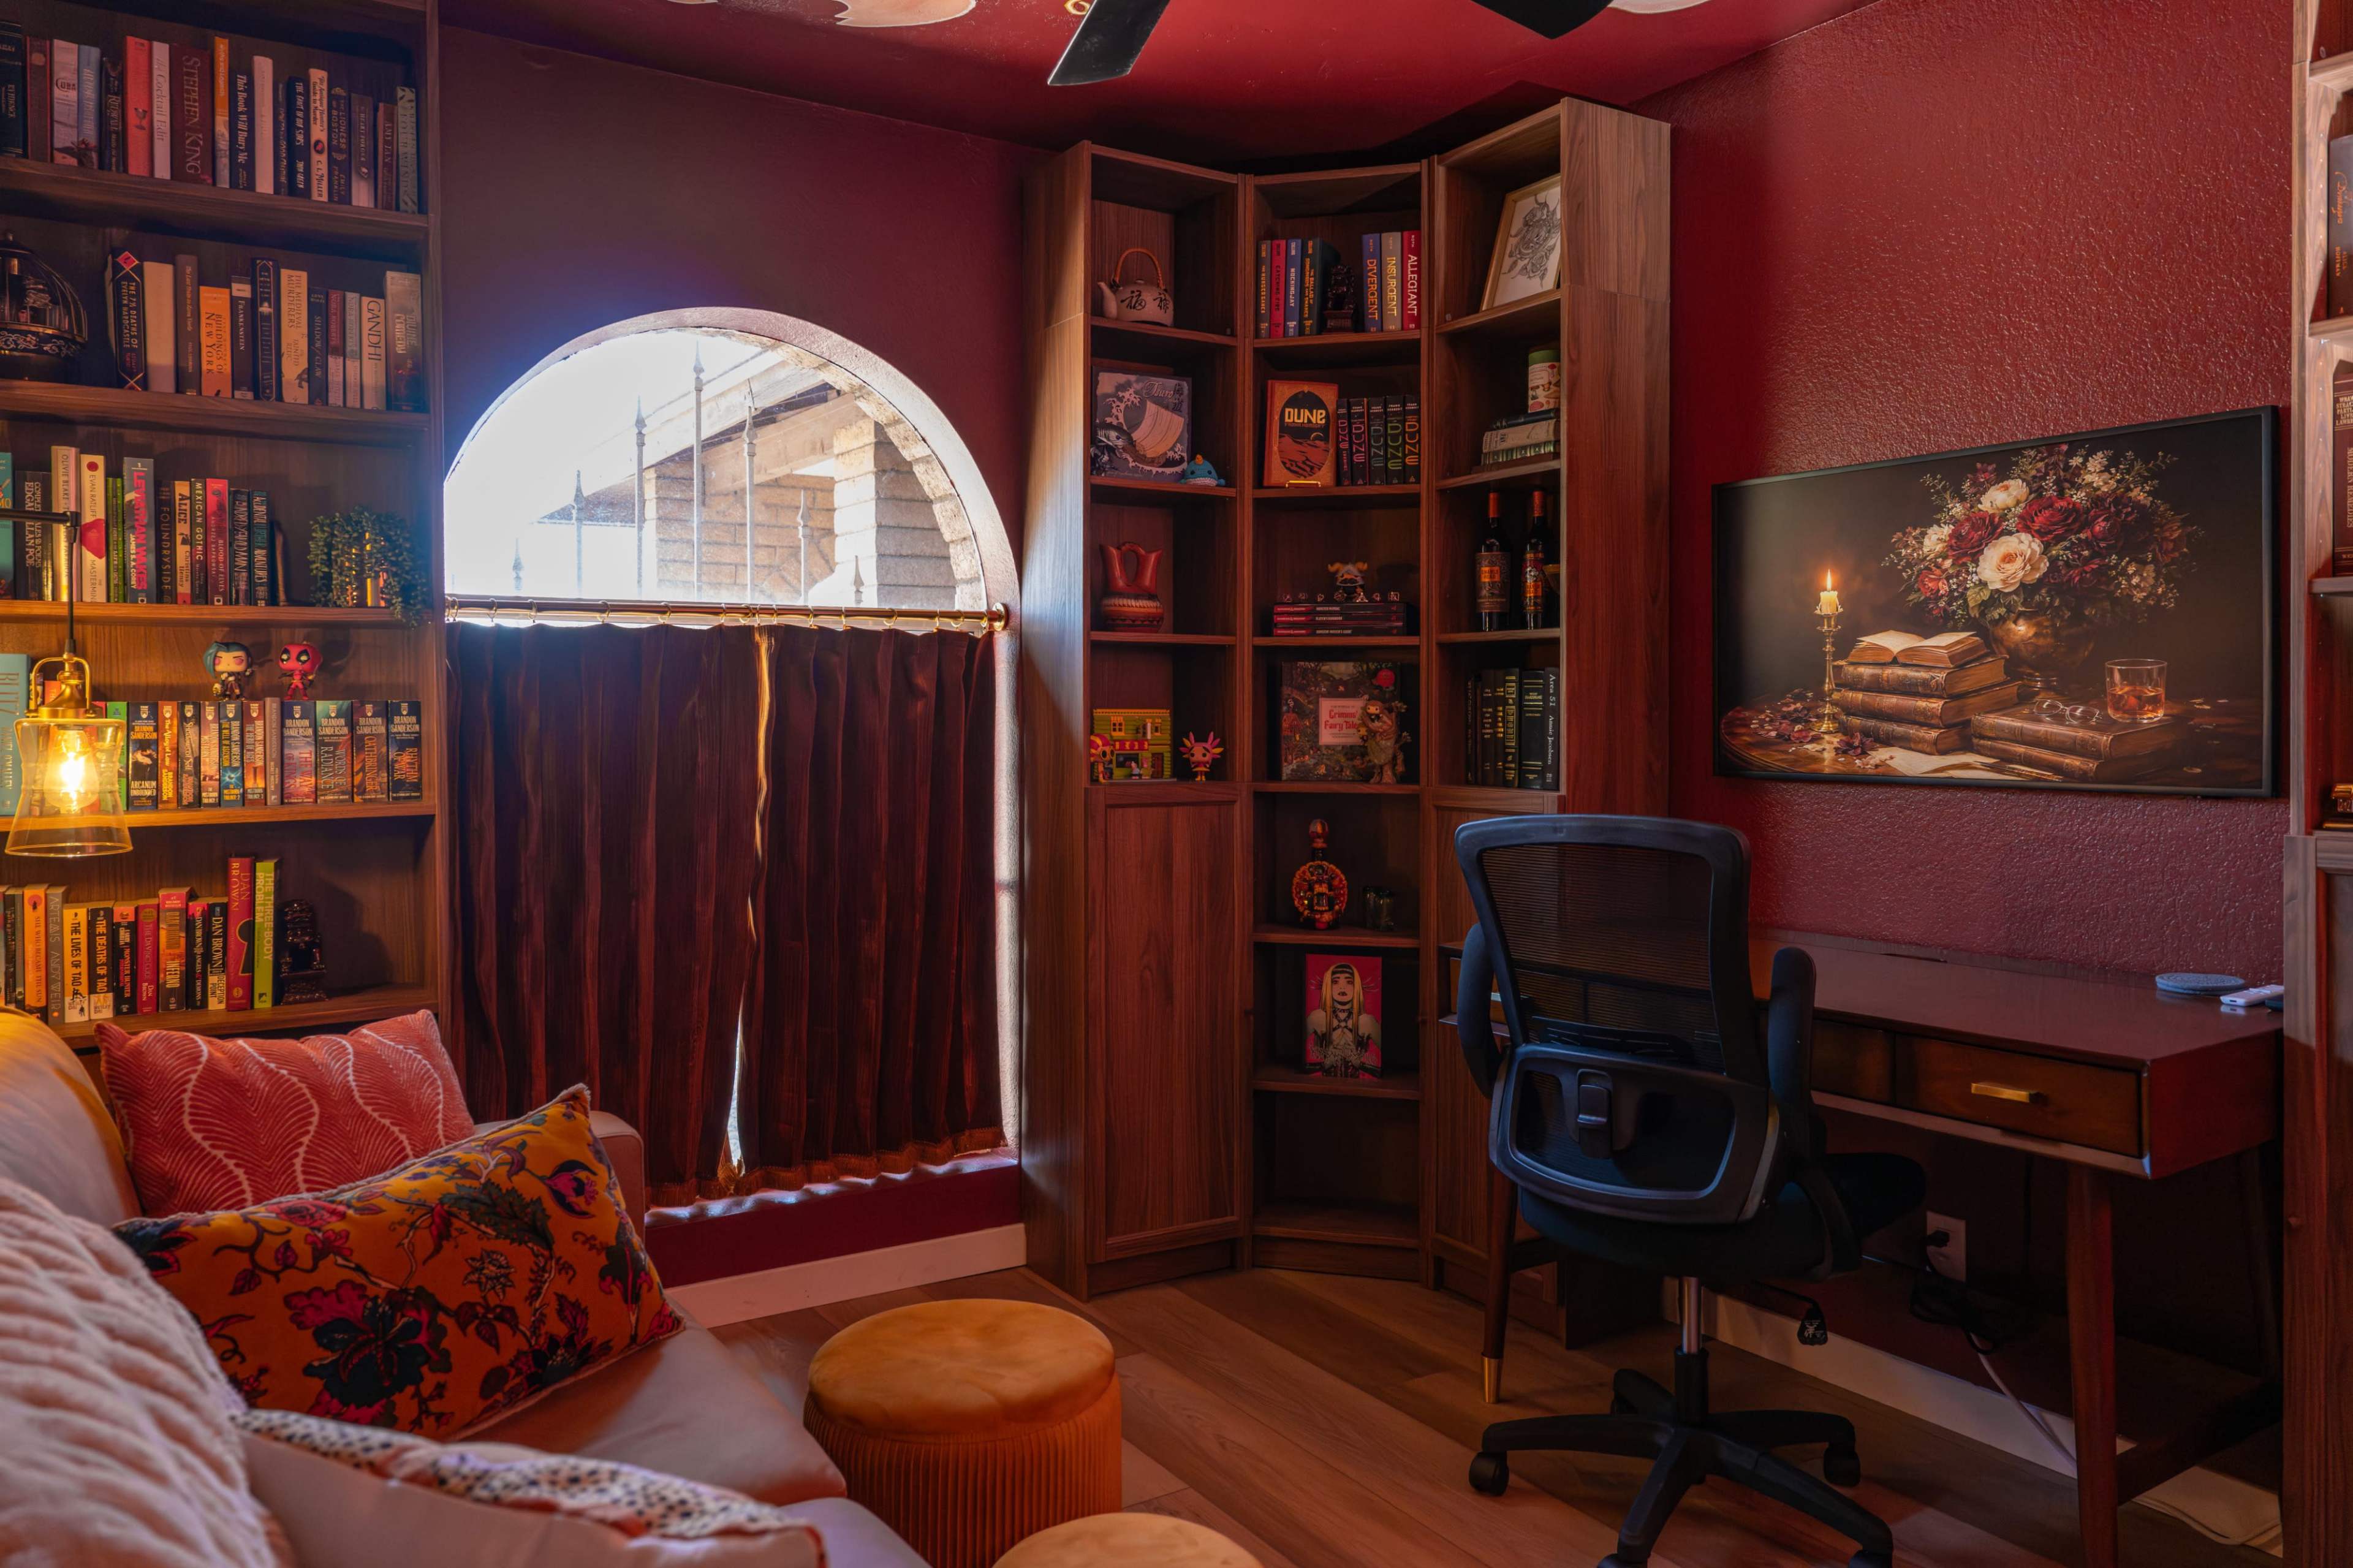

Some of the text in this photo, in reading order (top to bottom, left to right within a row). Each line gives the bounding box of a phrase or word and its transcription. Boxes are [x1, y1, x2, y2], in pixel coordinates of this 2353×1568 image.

[237, 74, 248, 90] This
[156, 74, 166, 142] Cocktail Edit
[183, 56, 203, 175] STEPHEN KING
[237, 93, 247, 112] Book
[237, 115, 248, 129] Will
[295, 129, 304, 146] STARS
[236, 131, 248, 150] Bury
[238, 152, 248, 164] Me
[316, 173, 325, 197] MILLER
[1367, 259, 1377, 320] DIVERGENT
[1387, 257, 1396, 316] INSURGENT
[1408, 254, 1418, 316] ALLEGIANT
[132, 338, 138, 348] OF
[205, 312, 216, 374] NEW YORK
[368, 300, 381, 361] GANDHI
[394, 314, 406, 353] COMEDY
[406, 315, 417, 346] DIVINE
[216, 365, 224, 373] OF
[1143, 381, 1173, 399] Tsuro
[1284, 407, 1326, 424] DUNE
[178, 493, 190, 524] ALICE
[133, 471, 148, 589] LEVIATHAN WAKES
[26, 548, 35, 566] POE
[161, 507, 171, 589] FOUNDRYSIDE
[235, 551, 248, 571] MAN
[254, 549, 267, 583] ADVENTURES
[1329, 710, 1358, 719] Grimms'
[1550, 695, 1555, 706] 51
[356, 725, 385, 734] SANDERSON
[1324, 721, 1343, 732] Fairy
[231, 721, 240, 767] BRANDON SANDERSON
[255, 721, 264, 766] BRANDON SANDERSON
[299, 751, 313, 767] THE
[284, 762, 296, 788] KINGS
[321, 746, 333, 789] RADIANCE
[335, 749, 346, 786] WORDS OF
[364, 736, 377, 790] OATHBRINGER
[393, 752, 406, 779] OF WAR
[406, 748, 418, 782] RHYTHM
[232, 863, 240, 911] BROWN
[240, 873, 250, 900] DAN
[264, 873, 275, 960] THE THREE-BODY
[49, 896, 61, 1010] ARTEMIS ANDY WEIR
[70, 922, 82, 987] THE LIVES OF TAO
[96, 920, 107, 993] THE DEATHS OF TAO
[211, 917, 222, 968] DAN BROWN
[166, 961, 180, 988] INFERNO
